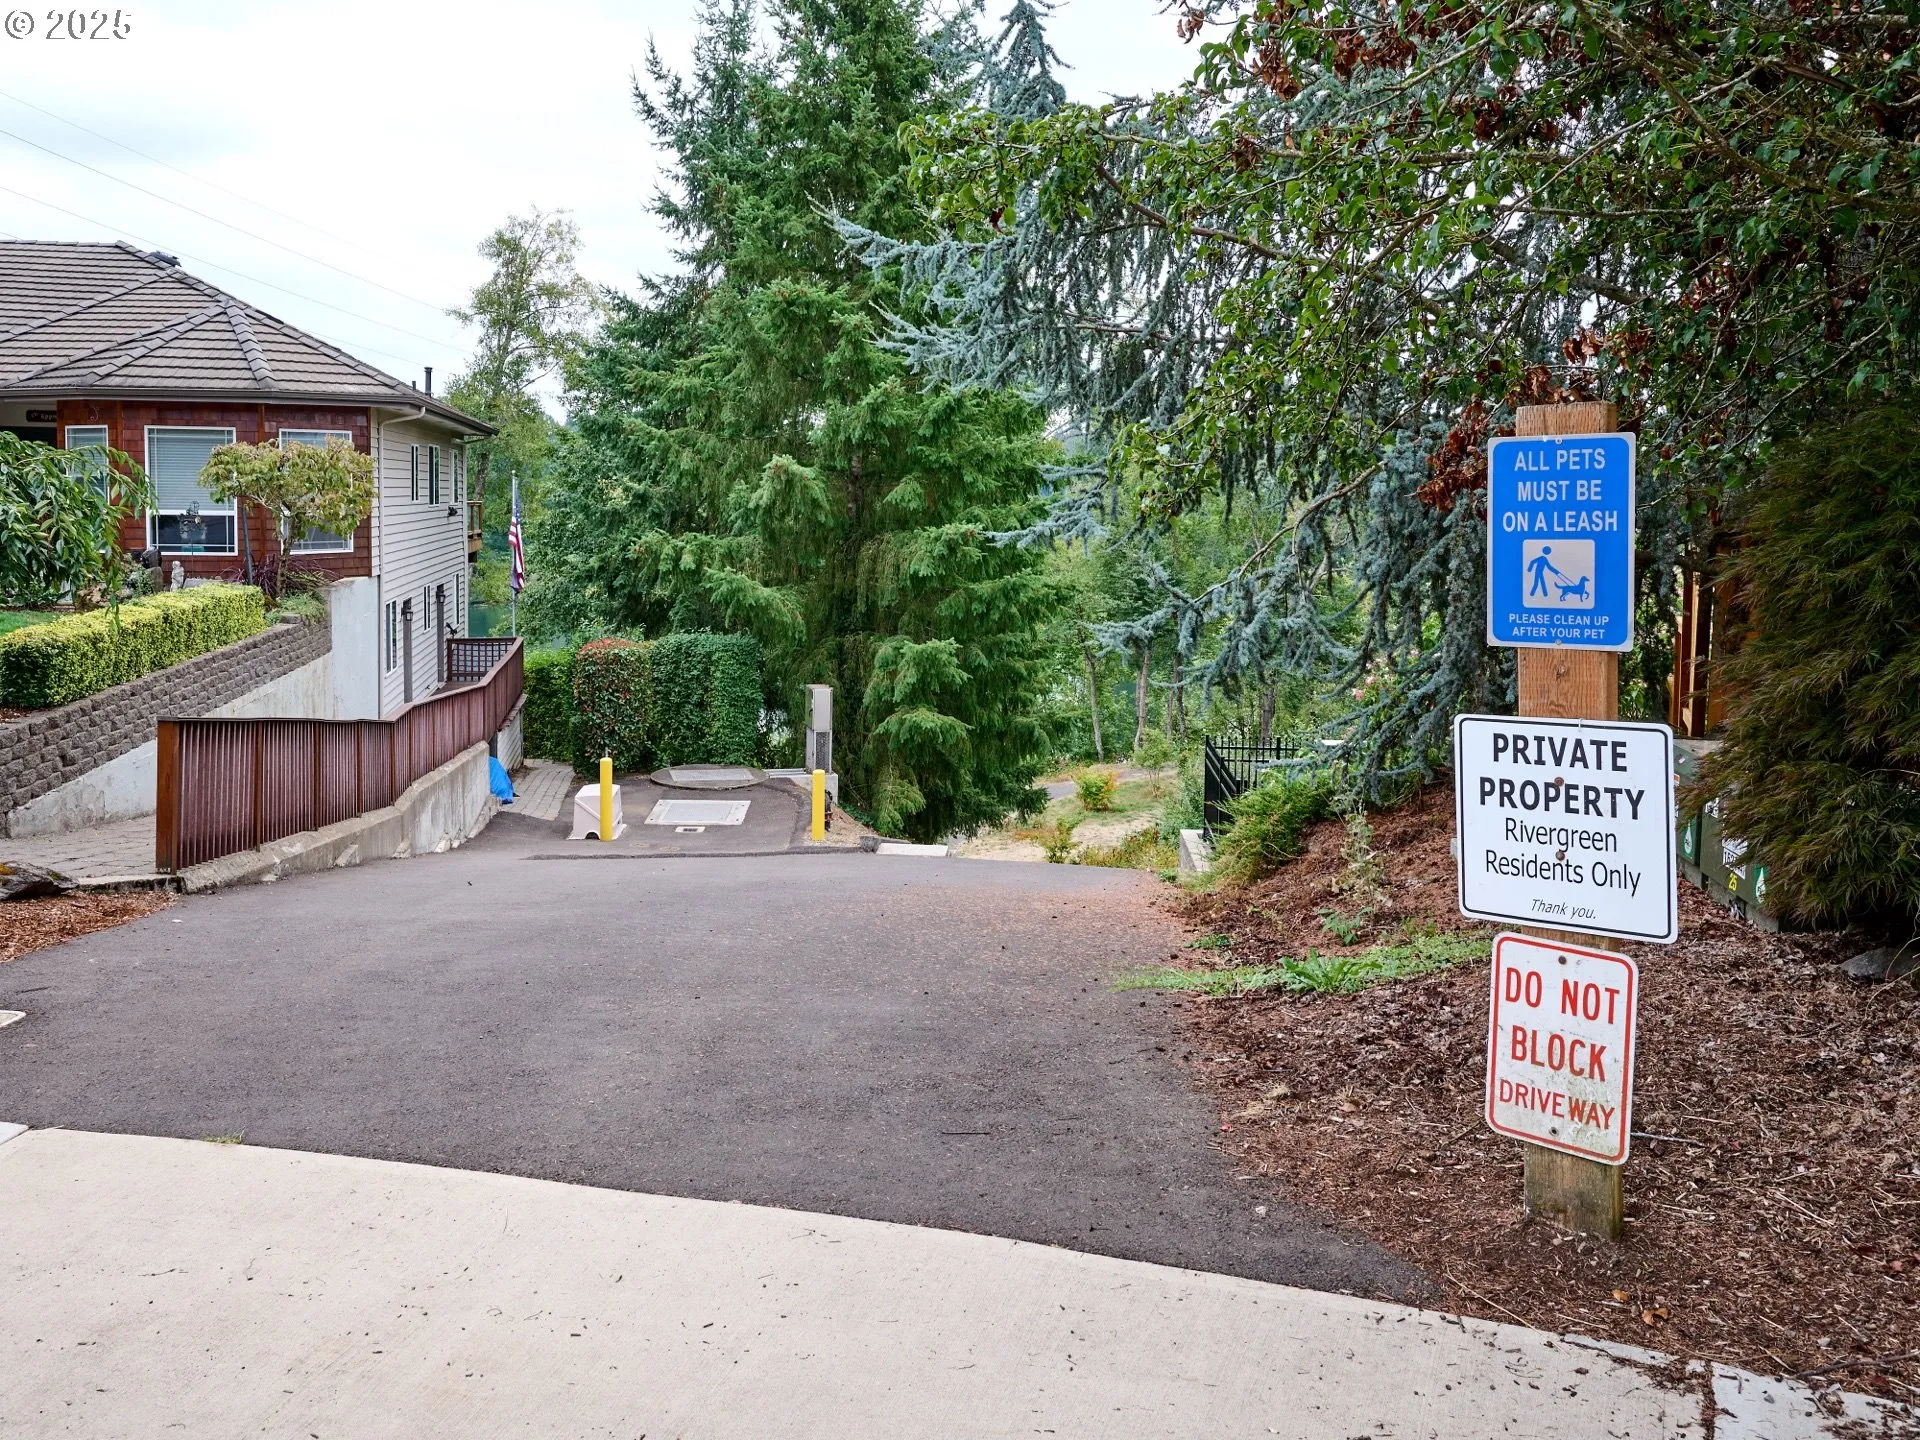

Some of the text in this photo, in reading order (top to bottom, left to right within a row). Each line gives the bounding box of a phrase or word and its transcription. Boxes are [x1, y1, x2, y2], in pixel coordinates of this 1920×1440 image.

[1514, 448, 1605, 471] ALL PETS
[1517, 480, 1602, 501] MUST BE
[1502, 510, 1618, 532] ON A LEASH
[1509, 613, 1609, 626] PLEASE CLEAN UP
[1512, 627, 1605, 639] AFTER YOUR PET
[1493, 733, 1627, 772] PRIVATE
[1479, 776, 1645, 820] PROPERTY
[1505, 817, 1617, 853] Rivergreen
[1486, 849, 1641, 897] Residents Only
[1531, 899, 1597, 920] Thank you.
[1505, 967, 1620, 1025] DO NOT
[1511, 1024, 1607, 1083] BLOCK
[1499, 1078, 1615, 1130] DRIVEWAY
